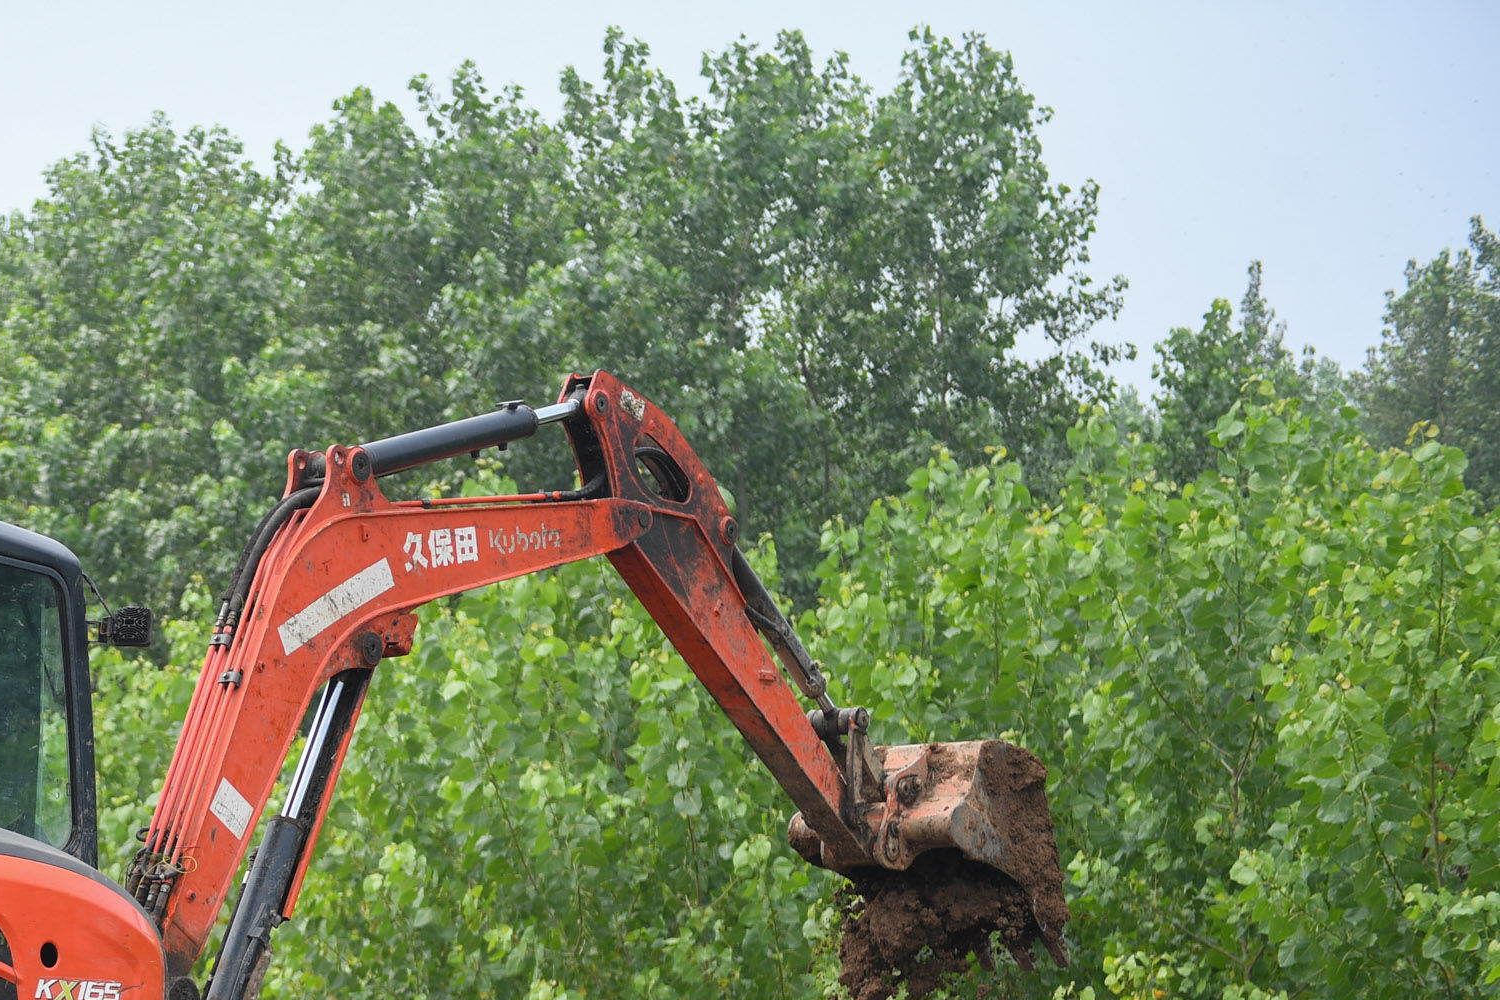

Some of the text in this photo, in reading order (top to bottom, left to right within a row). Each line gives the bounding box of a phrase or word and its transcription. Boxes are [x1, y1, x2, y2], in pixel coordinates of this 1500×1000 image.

[403, 522, 561, 572] 久保田 Kubota
